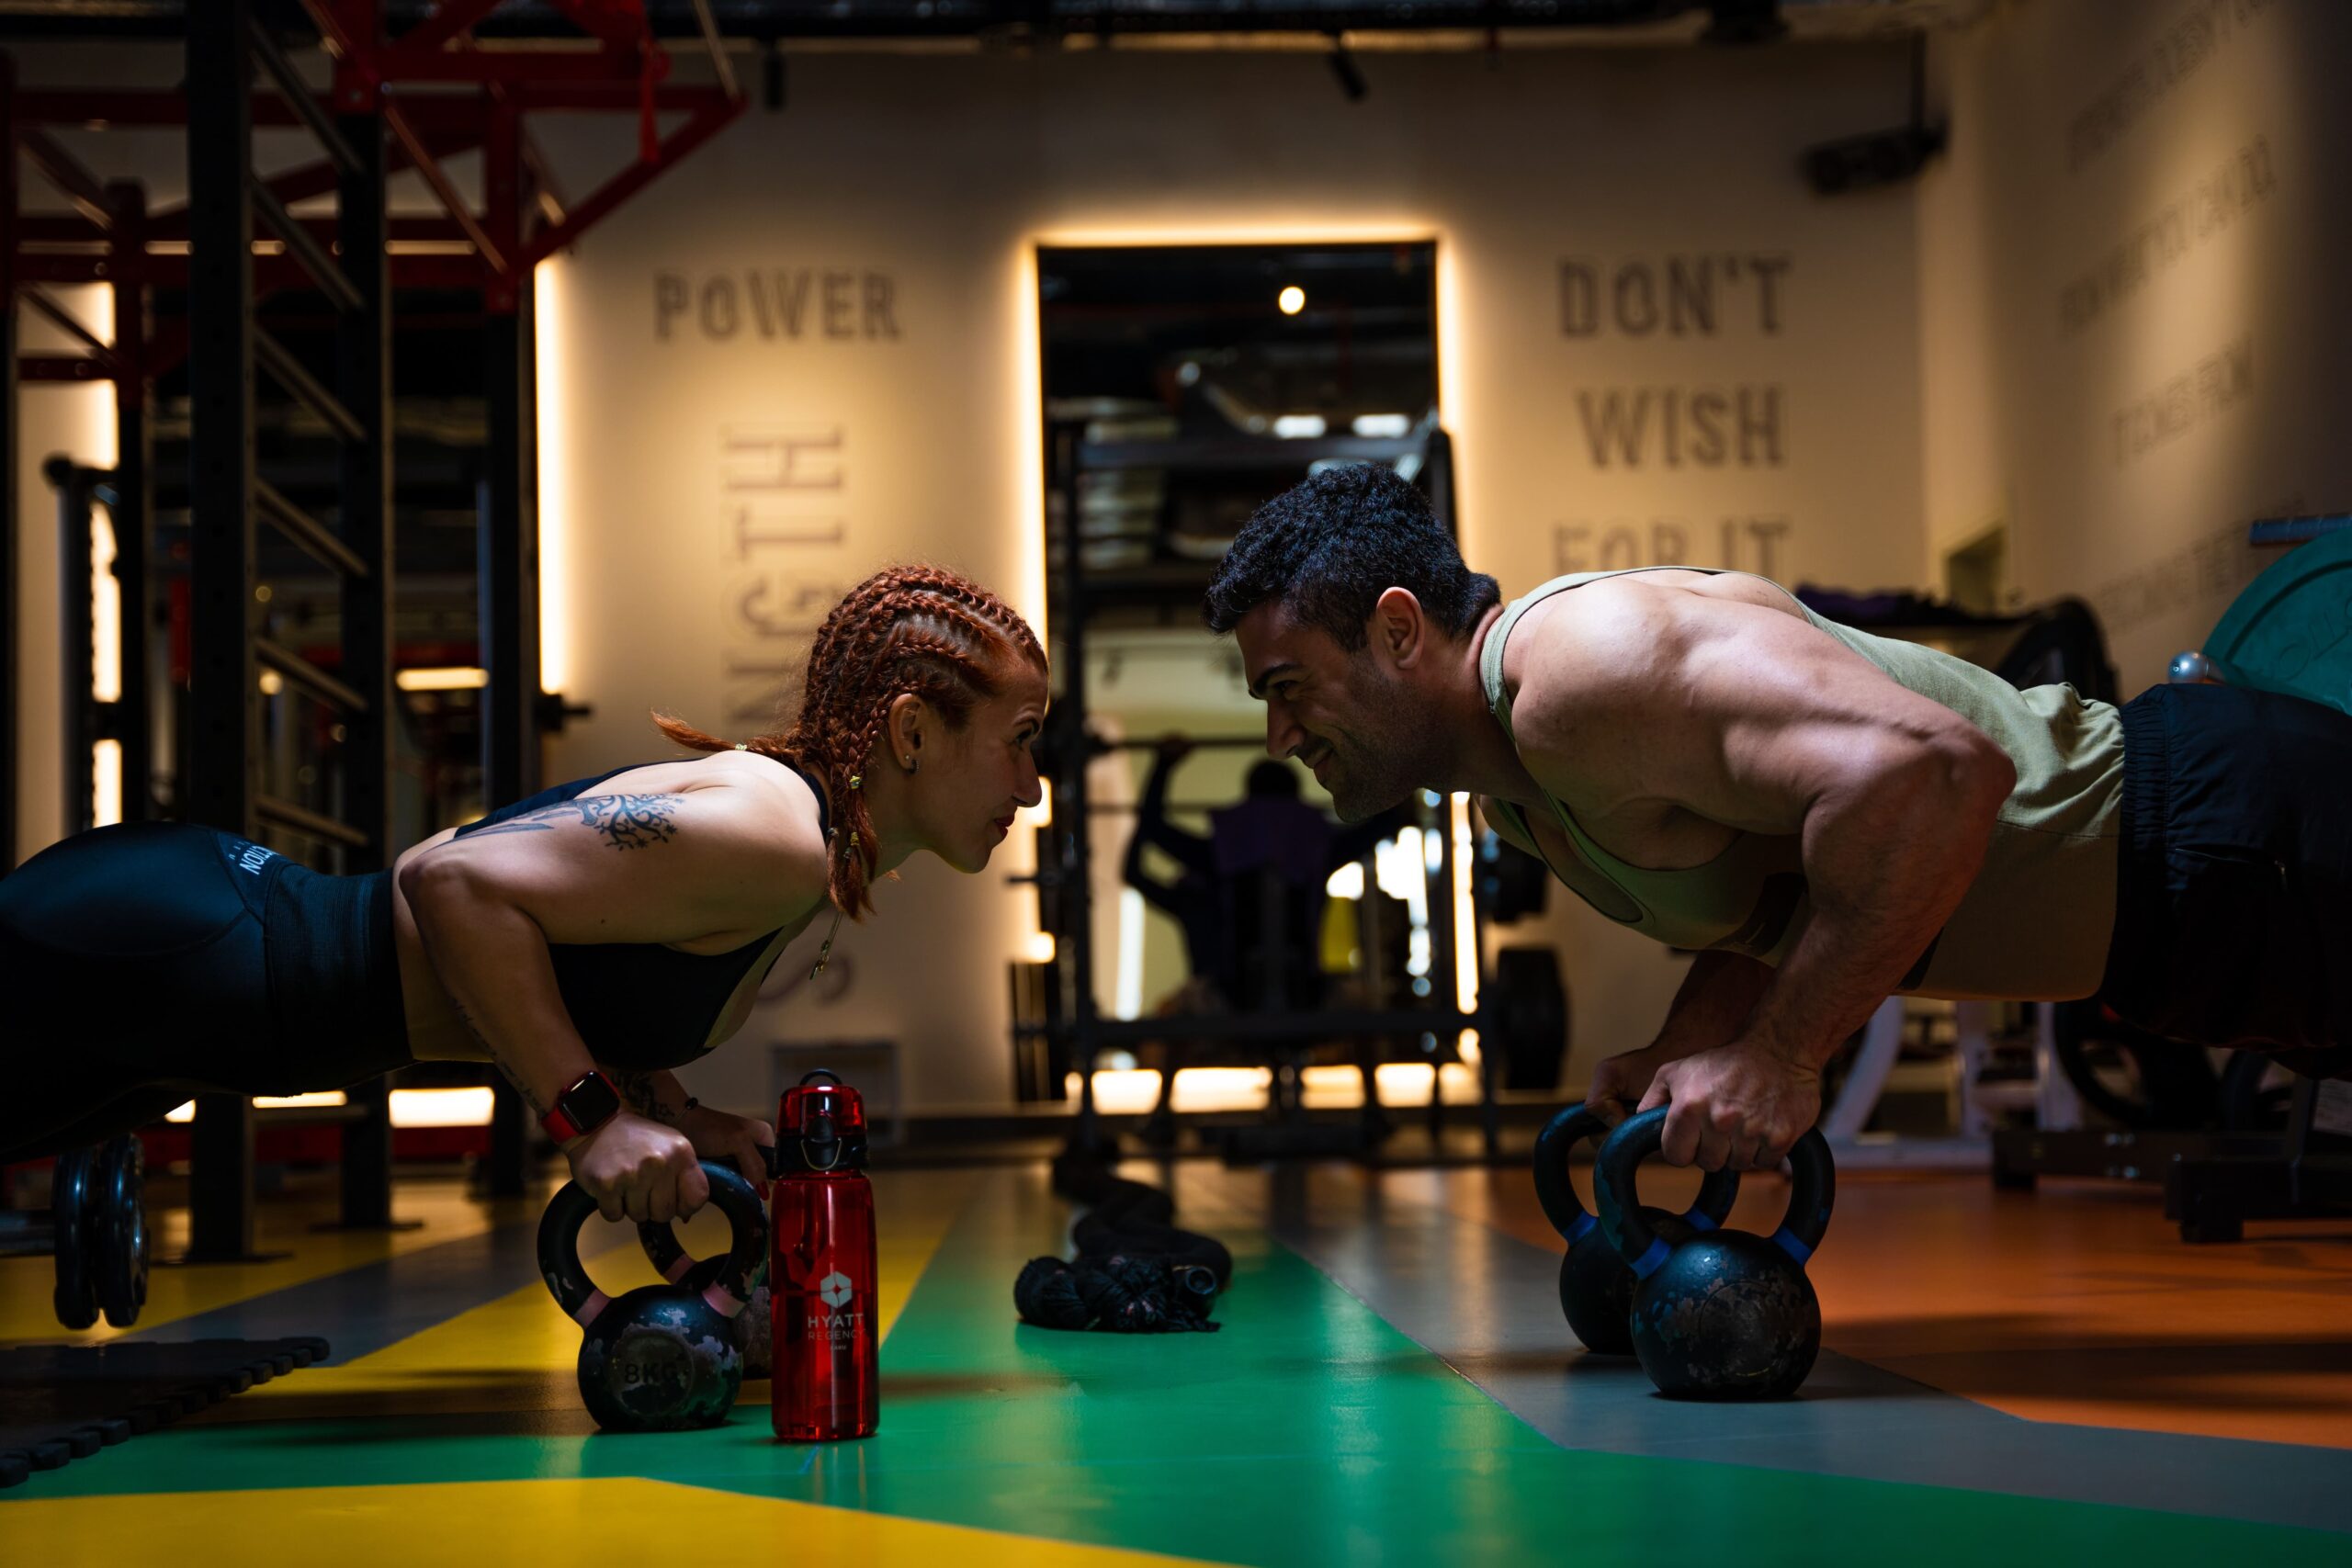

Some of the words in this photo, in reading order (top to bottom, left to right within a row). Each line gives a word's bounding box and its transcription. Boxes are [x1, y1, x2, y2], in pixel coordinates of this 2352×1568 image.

[653, 272, 903, 340] POWER
[1559, 255, 1792, 337] DON'T
[1577, 388, 1786, 468] WISH
[808, 1313, 865, 1328] HYATT
